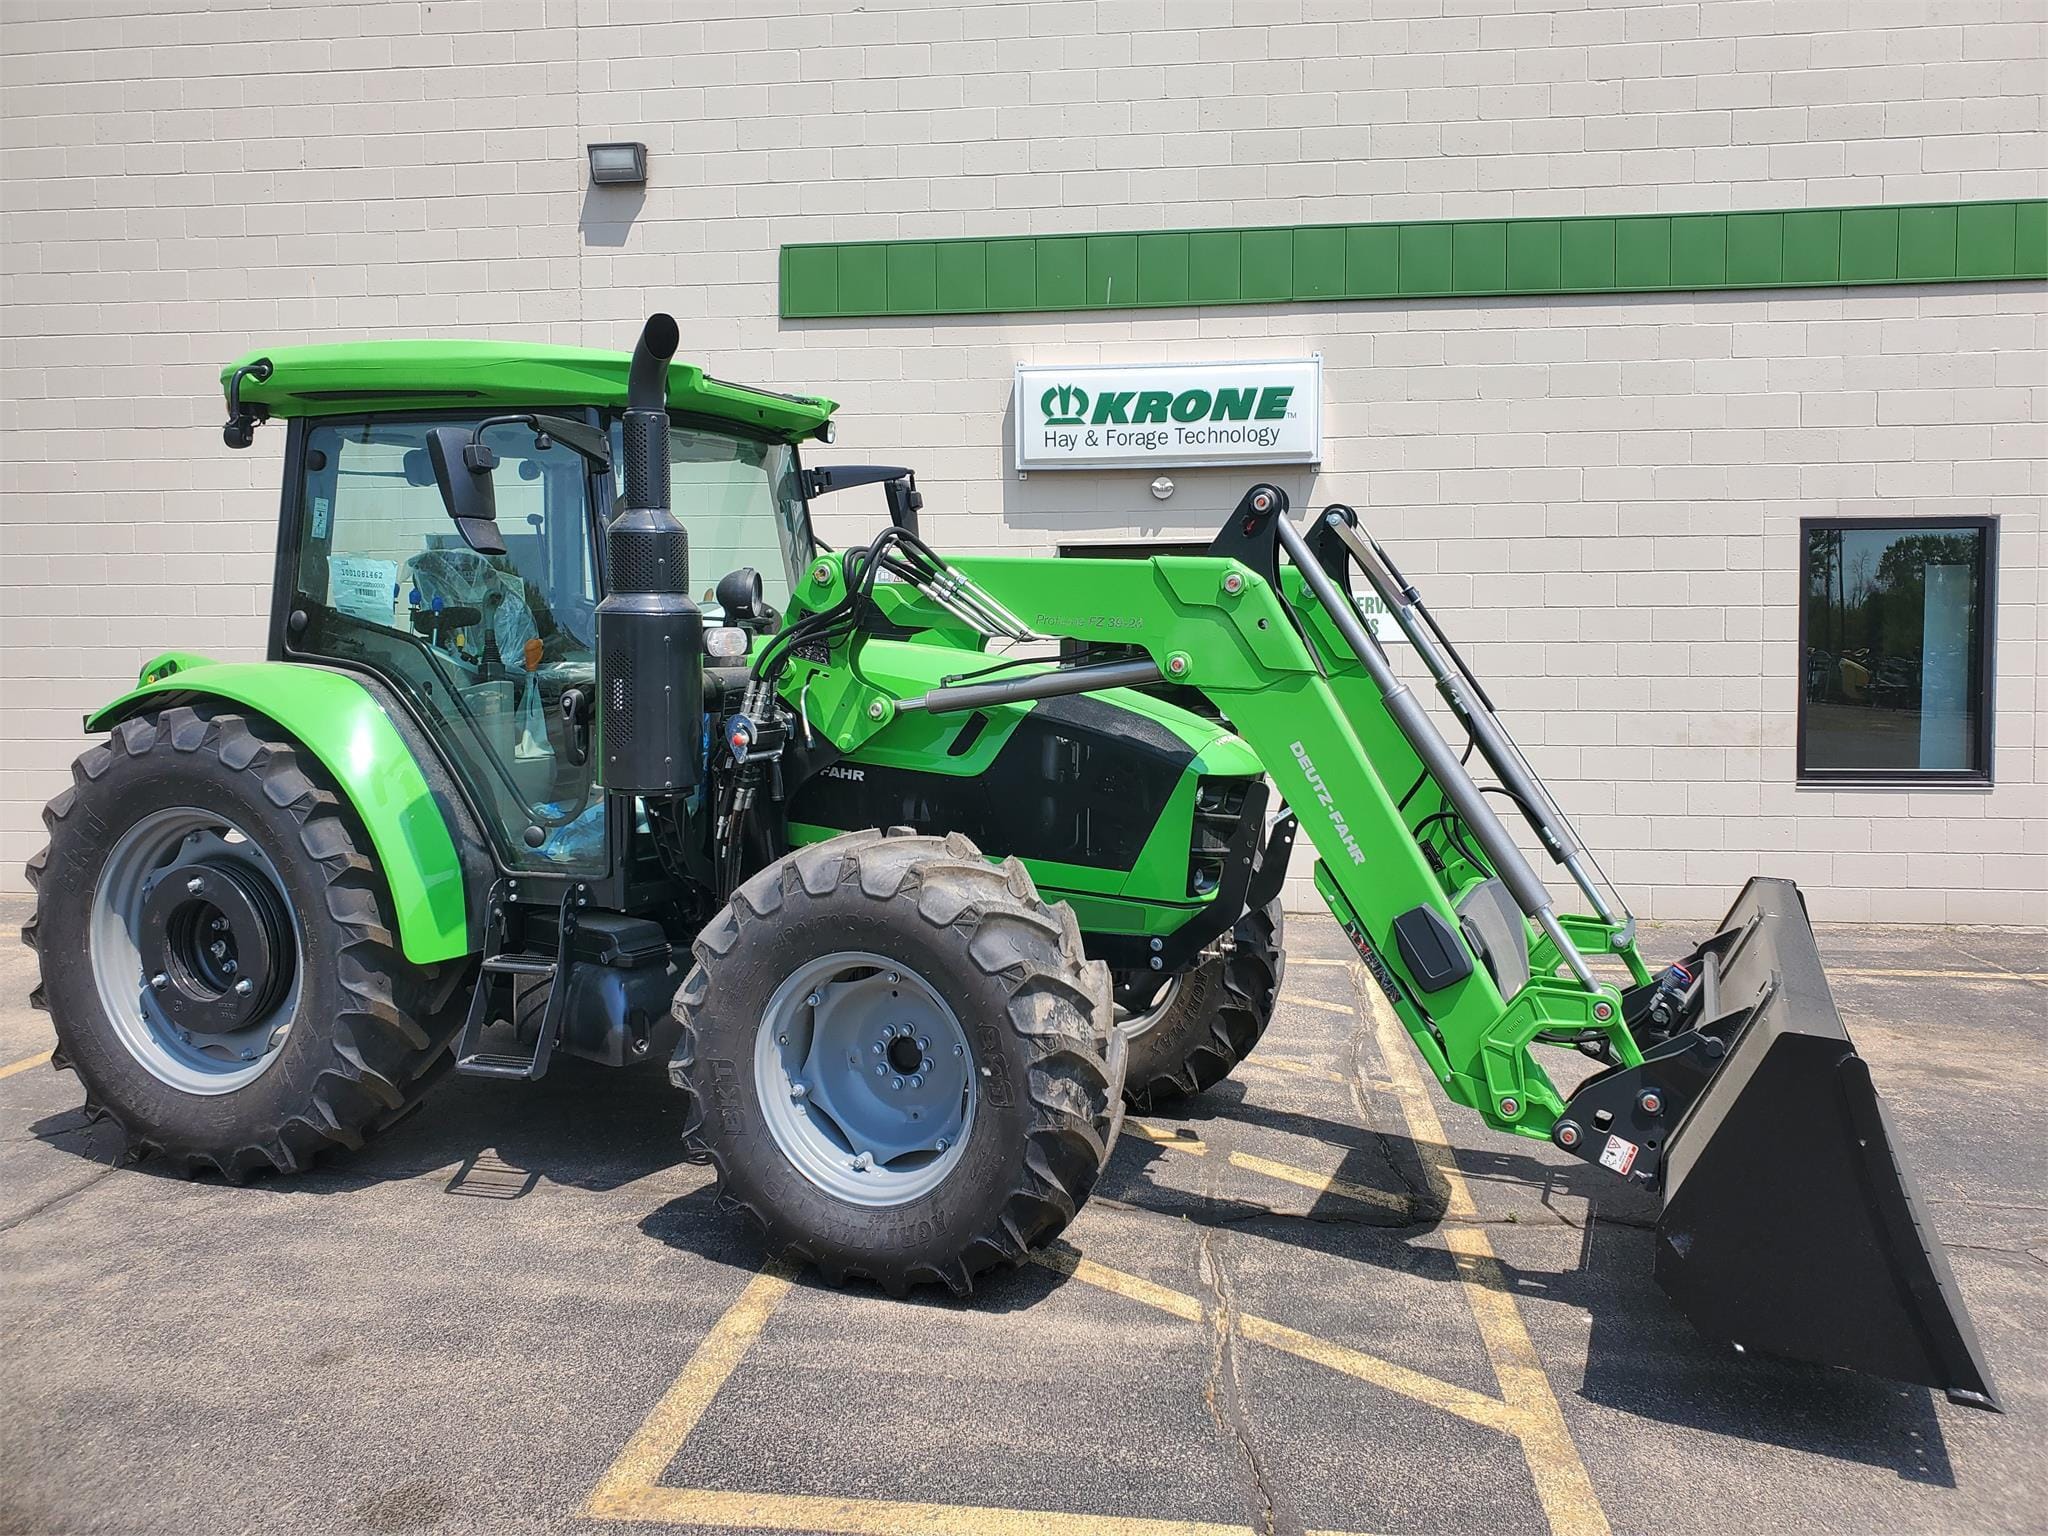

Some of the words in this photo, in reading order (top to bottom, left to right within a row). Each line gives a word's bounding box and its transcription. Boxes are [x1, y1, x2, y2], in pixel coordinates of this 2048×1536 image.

[1091, 386, 1295, 425] KRONE
[1044, 430, 1078, 451] Hay
[1085, 429, 1099, 447] &
[1106, 428, 1168, 450] Forage
[1175, 425, 1281, 448] Technology
[1356, 596, 1389, 614] ERV
[1289, 740, 1366, 867] DEUTZ-FAHR
